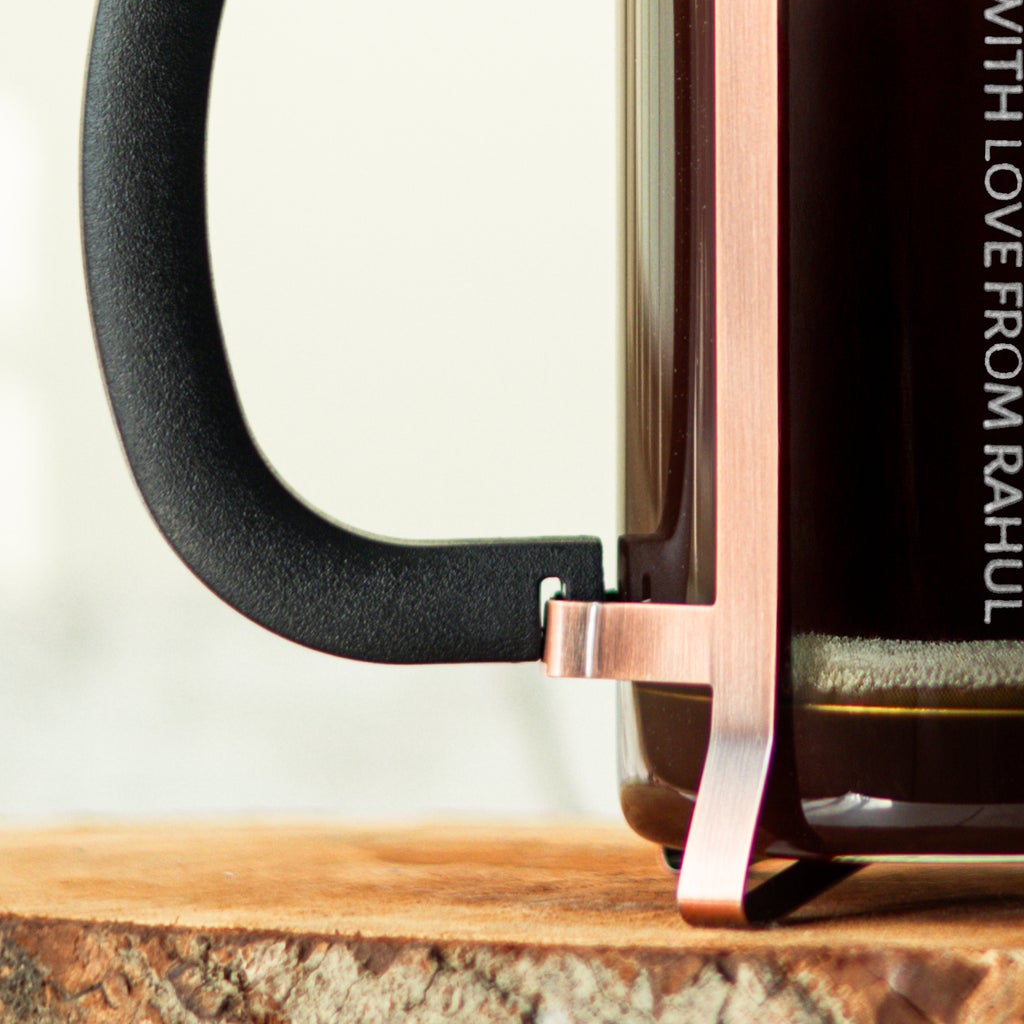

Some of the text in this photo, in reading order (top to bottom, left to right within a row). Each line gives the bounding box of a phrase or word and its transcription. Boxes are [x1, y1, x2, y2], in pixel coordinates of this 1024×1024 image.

[983, 139, 1024, 268] LOVE
[983, 281, 1024, 430] FROM
[983, 444, 1024, 625] RAHUL
